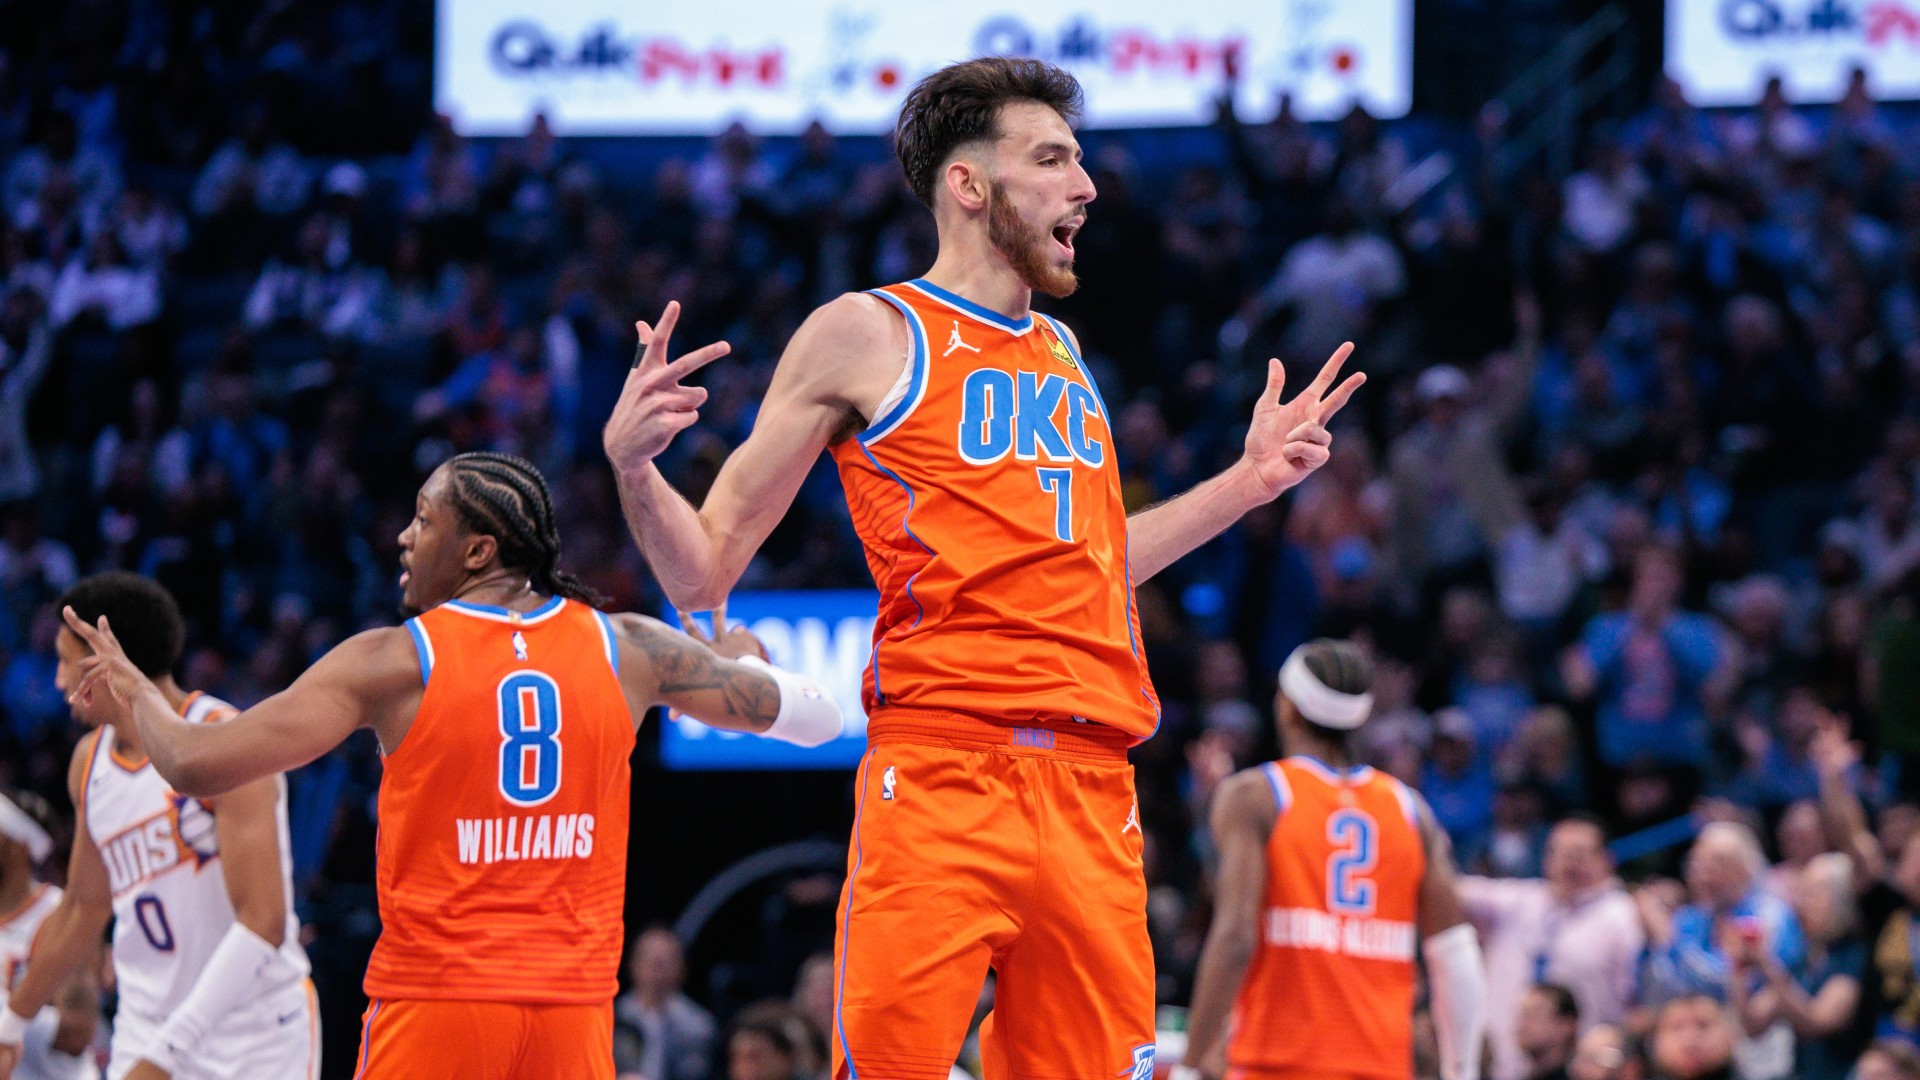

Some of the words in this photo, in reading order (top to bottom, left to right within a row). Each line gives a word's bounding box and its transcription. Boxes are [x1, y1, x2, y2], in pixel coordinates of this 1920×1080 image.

[958, 368, 1104, 468] OKC
[1036, 467, 1074, 542] 7
[497, 669, 562, 807] 8
[101, 815, 179, 893] UNS
[456, 813, 594, 864] WILLIAMS
[1326, 807, 1379, 917] 2
[135, 894, 175, 951] 0
